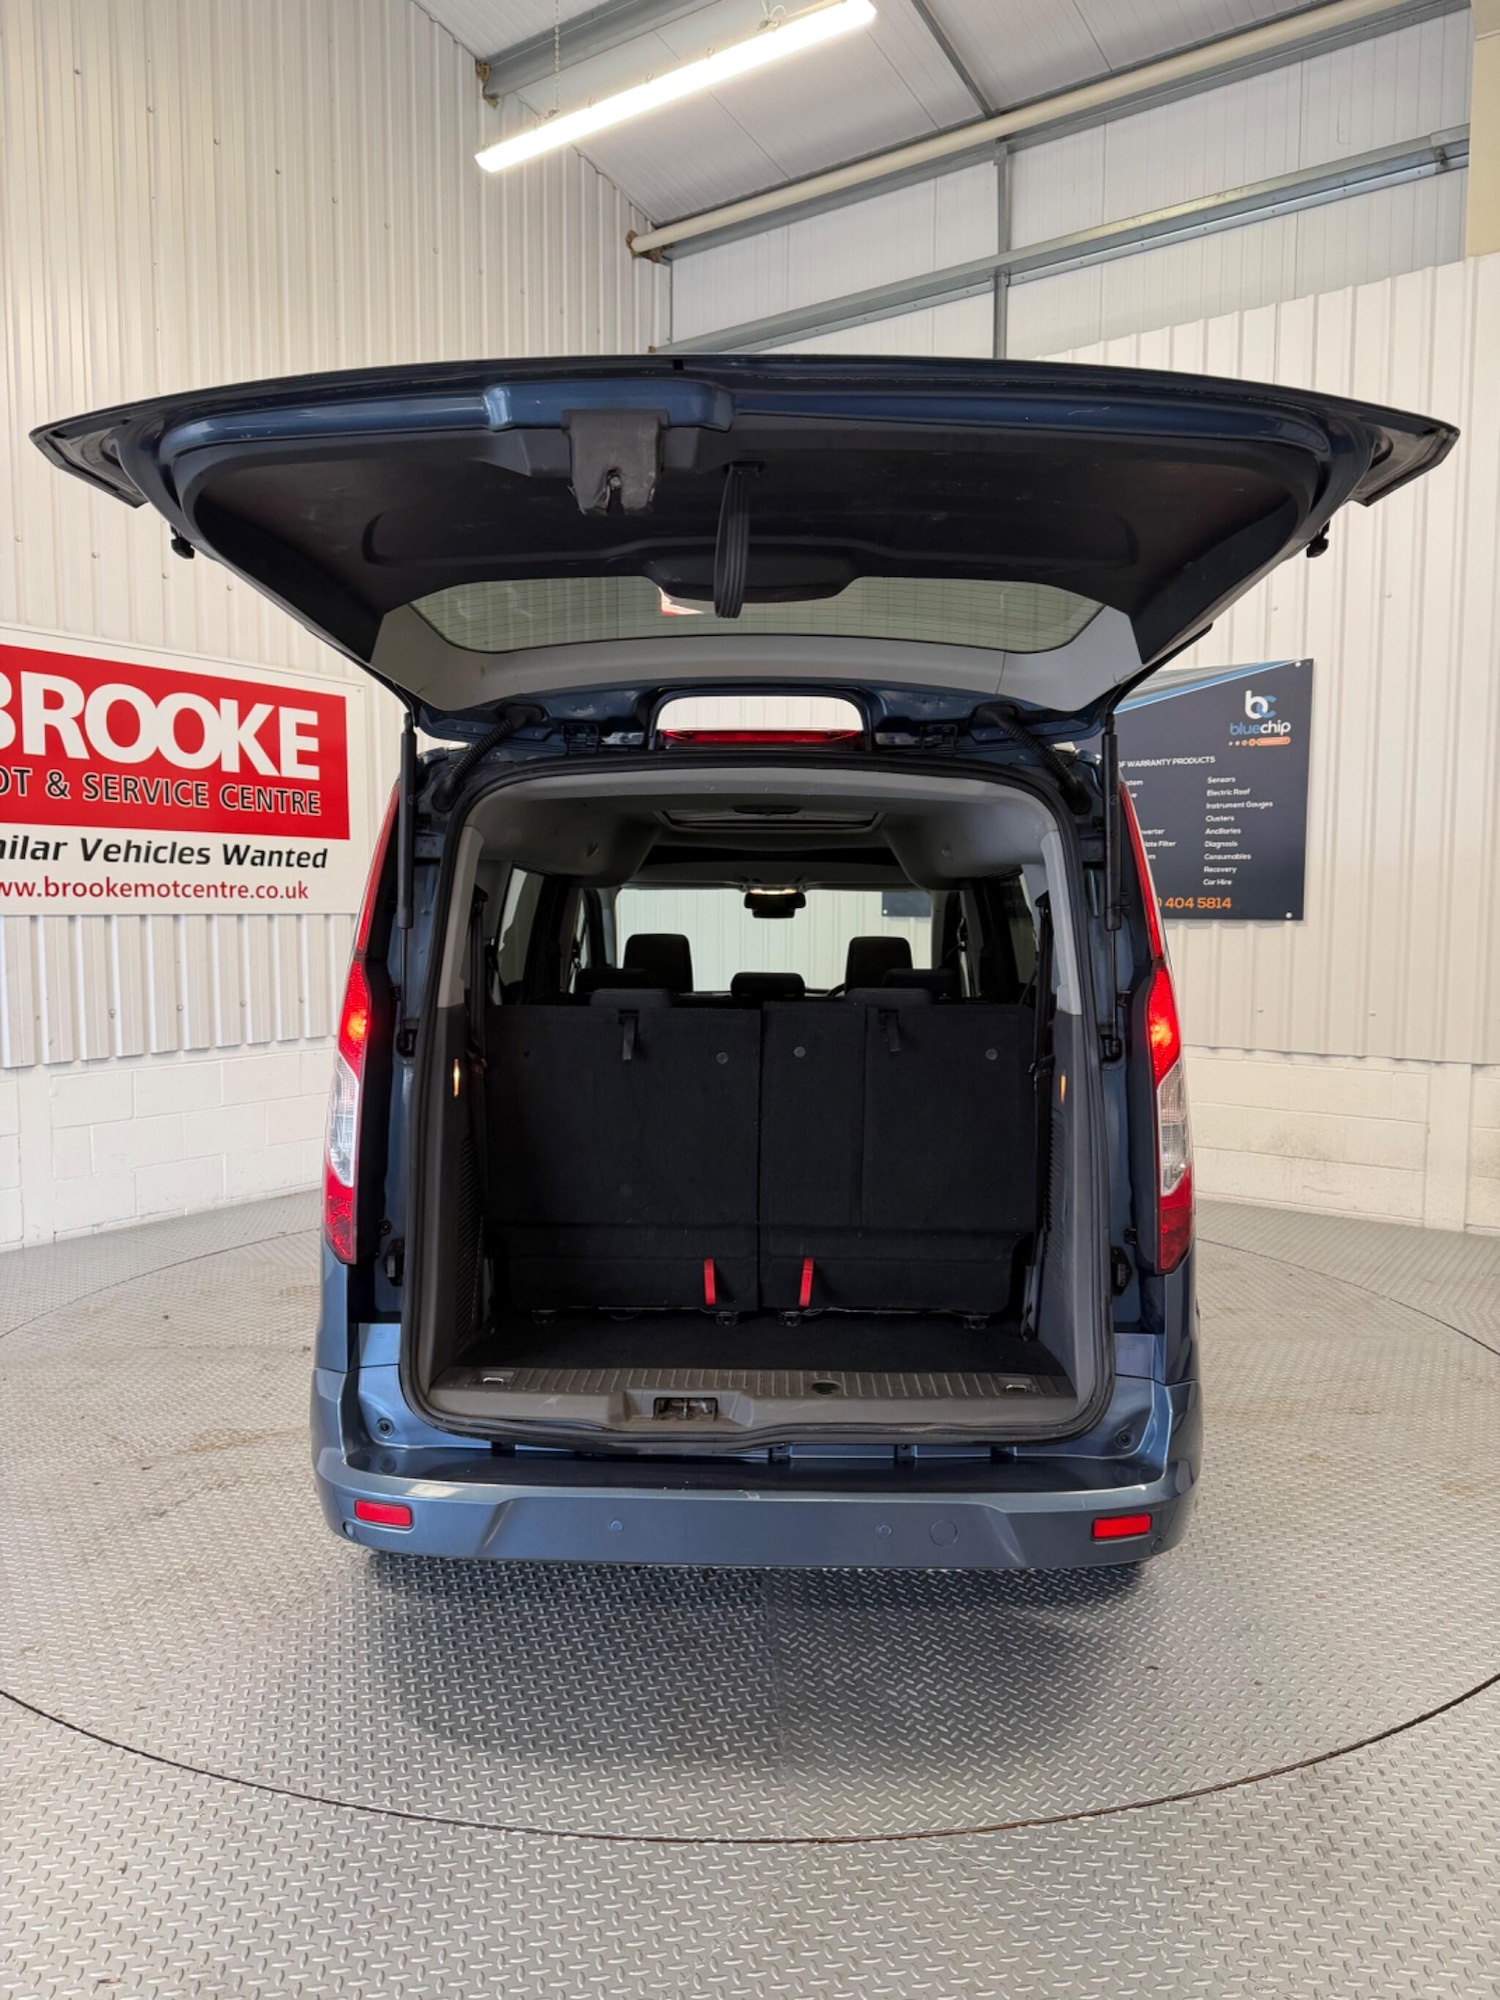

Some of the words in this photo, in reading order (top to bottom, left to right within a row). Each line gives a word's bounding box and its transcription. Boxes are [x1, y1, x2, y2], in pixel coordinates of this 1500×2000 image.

[0, 671, 320, 781] ROOKE
[1230, 720, 1291, 736] bluechip
[1127, 758, 1171, 767] WARRANTY
[1172, 756, 1216, 765] PRODUCTS
[1207, 776, 1236, 784] Sensors
[45, 769, 70, 800] &
[82, 773, 209, 808] SERVICE
[220, 783, 321, 816] CENTRE
[1207, 789, 1232, 797] Electric
[1233, 788, 1251, 796] Roof
[1246, 801, 1273, 809] Gauges
[1204, 840, 1238, 849] Diagnosis
[0, 835, 68, 861] ilar
[81, 838, 211, 866] Vehicles
[222, 843, 328, 868] Wanted
[1217, 878, 1232, 886] Hire
[1165, 897, 1194, 909] 404
[1197, 897, 1232, 909] 5814
